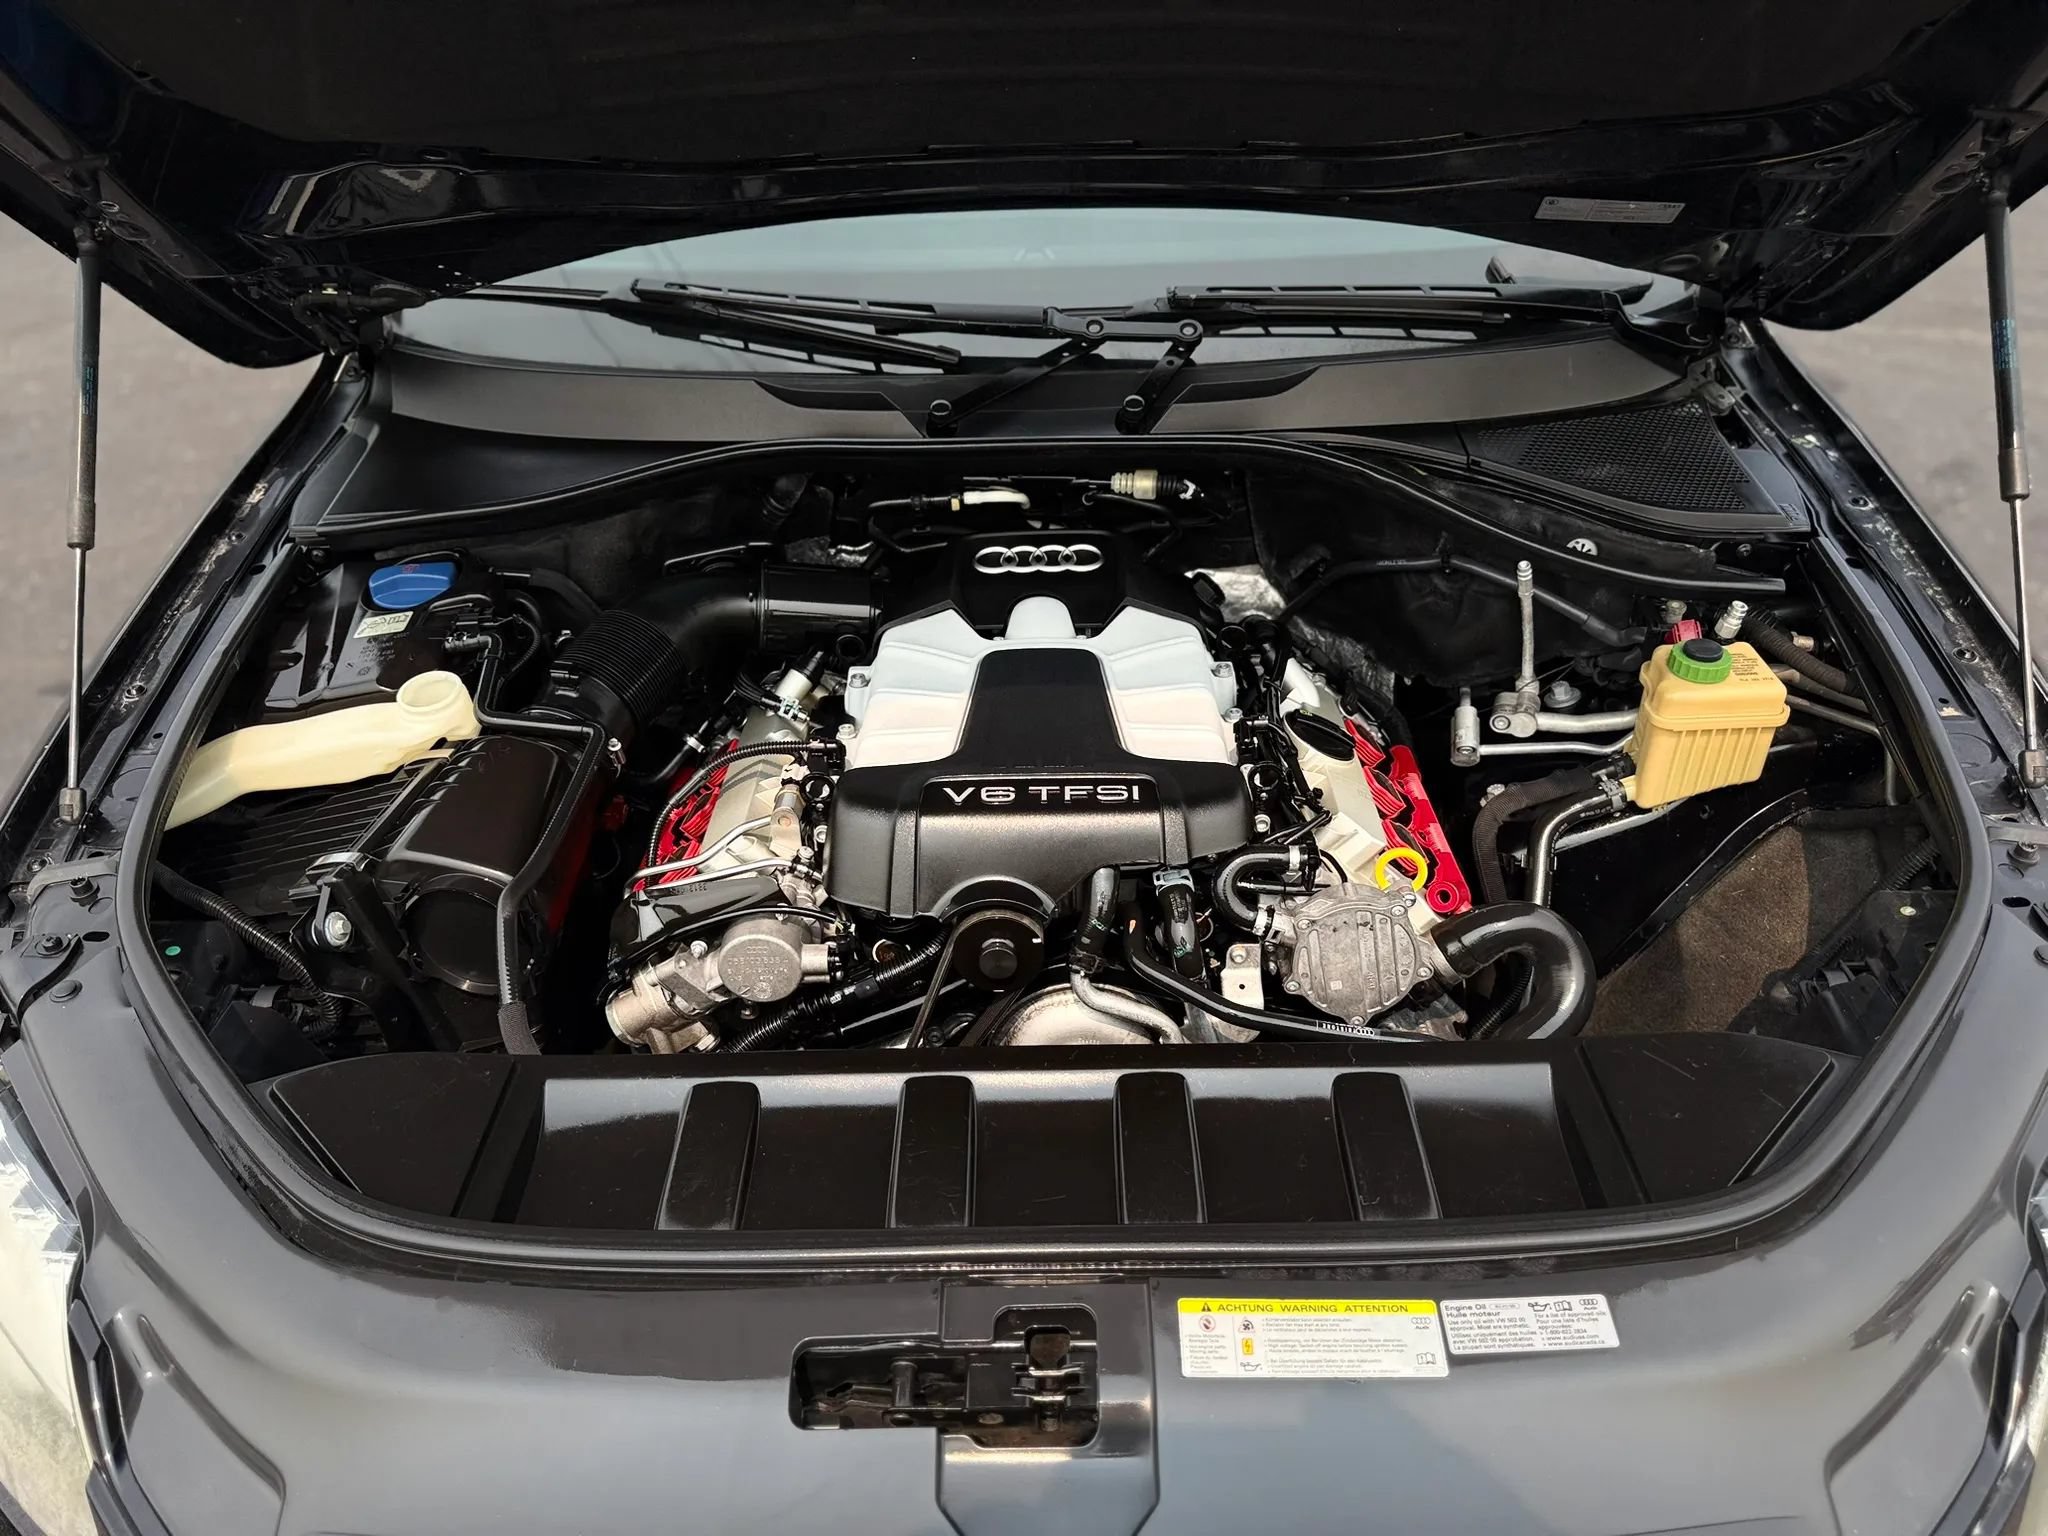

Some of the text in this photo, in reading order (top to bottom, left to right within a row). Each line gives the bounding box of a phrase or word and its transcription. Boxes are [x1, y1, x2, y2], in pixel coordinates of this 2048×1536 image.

[942, 785, 1140, 805] V6 TFSI
[1217, 1304, 1408, 1313] ACHTUNG WARNING ATTENTION
